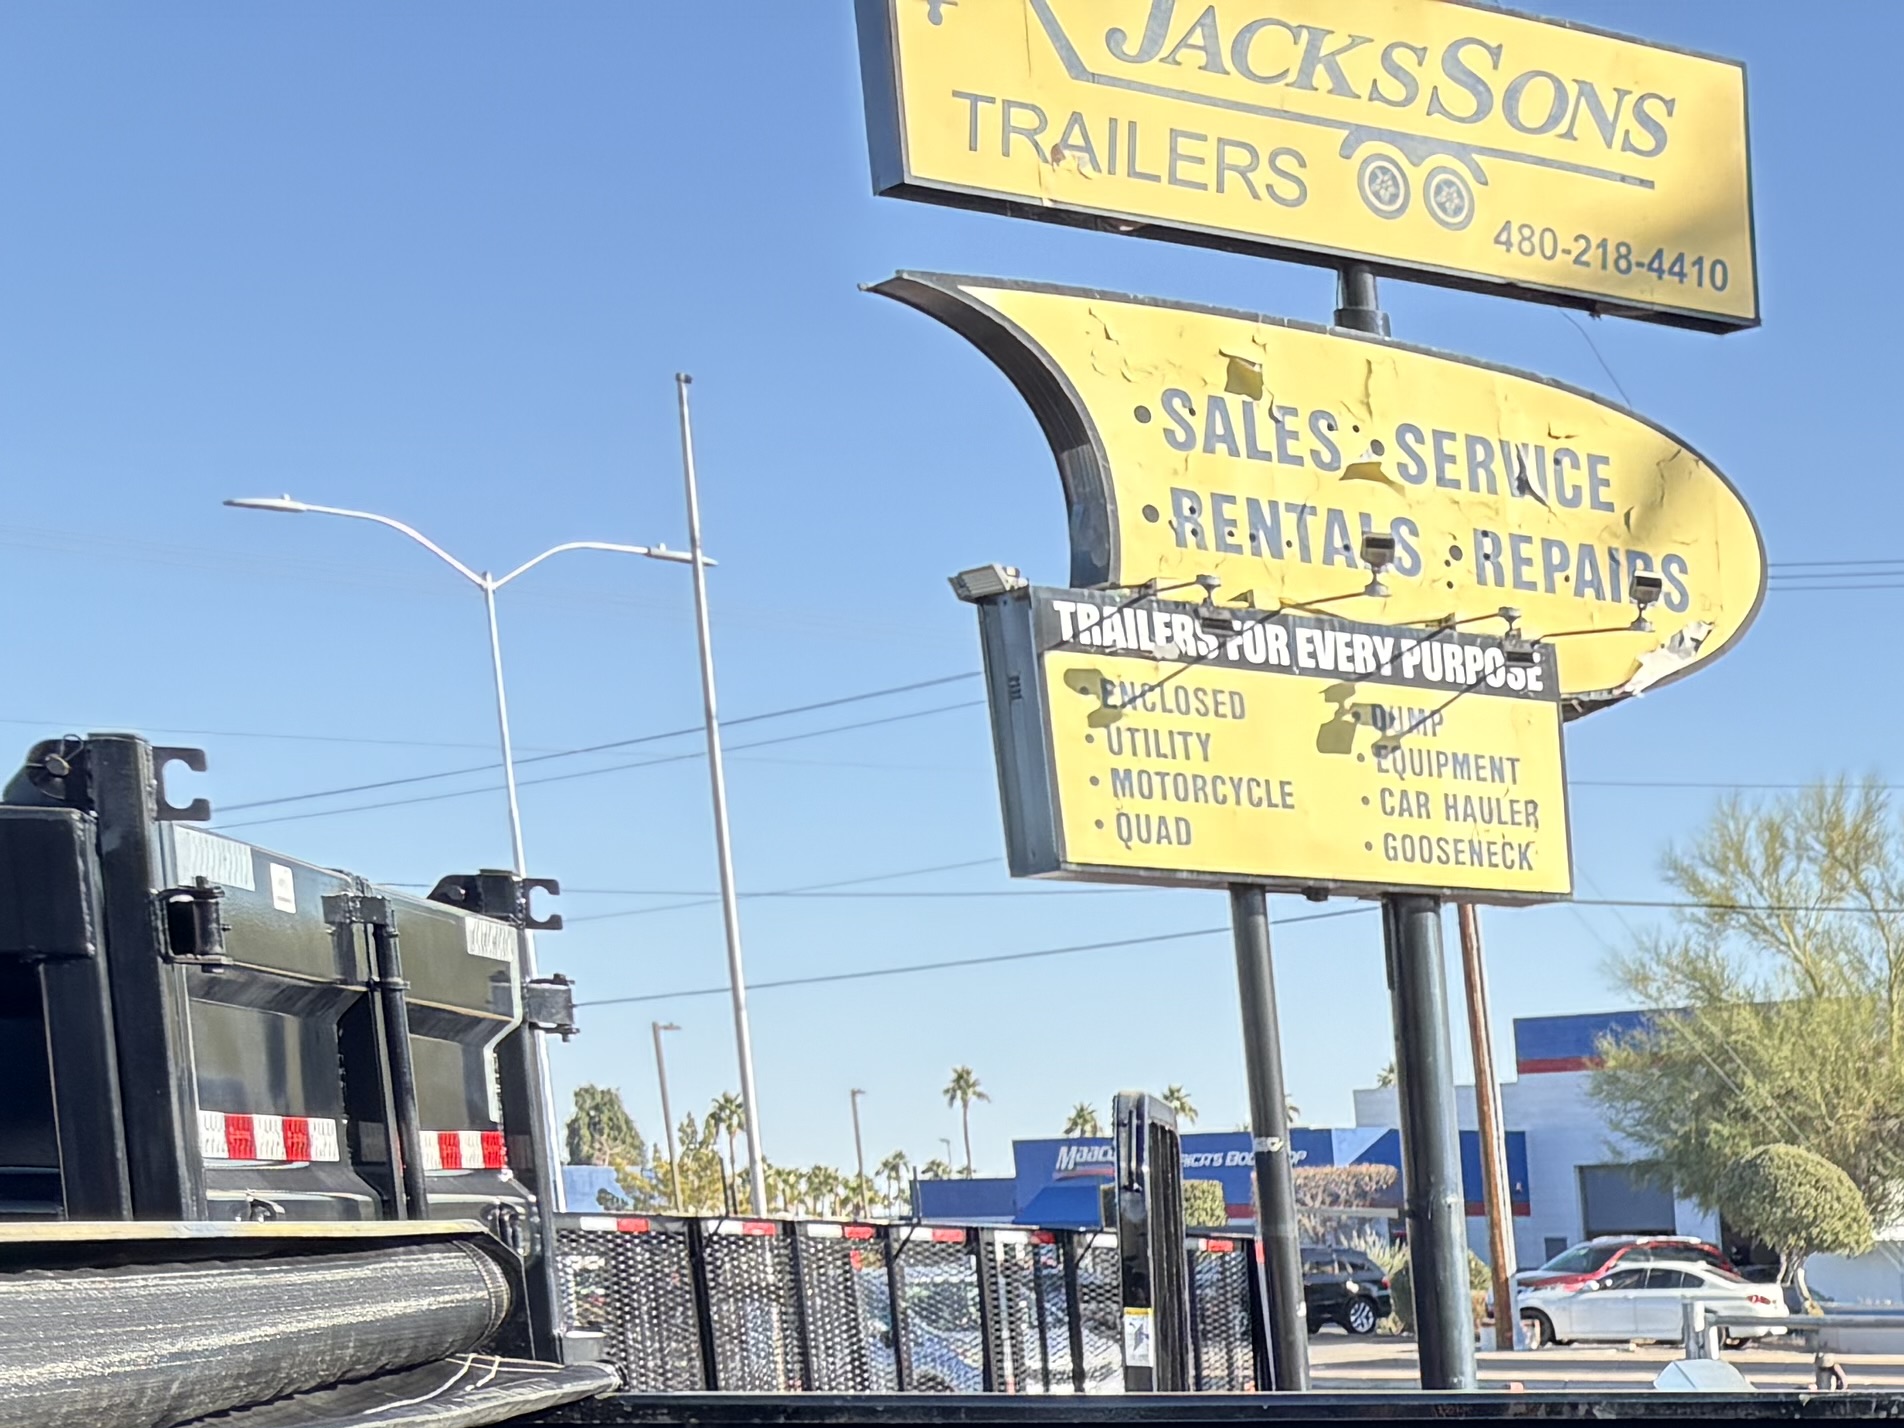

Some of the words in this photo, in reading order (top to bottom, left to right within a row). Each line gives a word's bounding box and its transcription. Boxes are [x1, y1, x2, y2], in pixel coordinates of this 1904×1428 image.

[951, 89, 1308, 207] TRAILERS
[1493, 220, 1730, 293] 480-218-4410
[1161, 388, 1342, 472] SALES
[1395, 422, 1616, 513] SERVICE
[1296, 627, 1394, 677] EVERY
[1100, 678, 1246, 720] ENCLOSED
[1371, 703, 1444, 737] DUMP
[1106, 725, 1211, 762] UTILITY
[1374, 745, 1521, 785] EQUIPMENT
[1110, 767, 1295, 810] MOTORCYCLE
[1380, 787, 1431, 819] CAR
[1444, 793, 1539, 829] HAULER
[1115, 811, 1192, 851] QUAD
[1383, 832, 1533, 871] GOOSENECK
